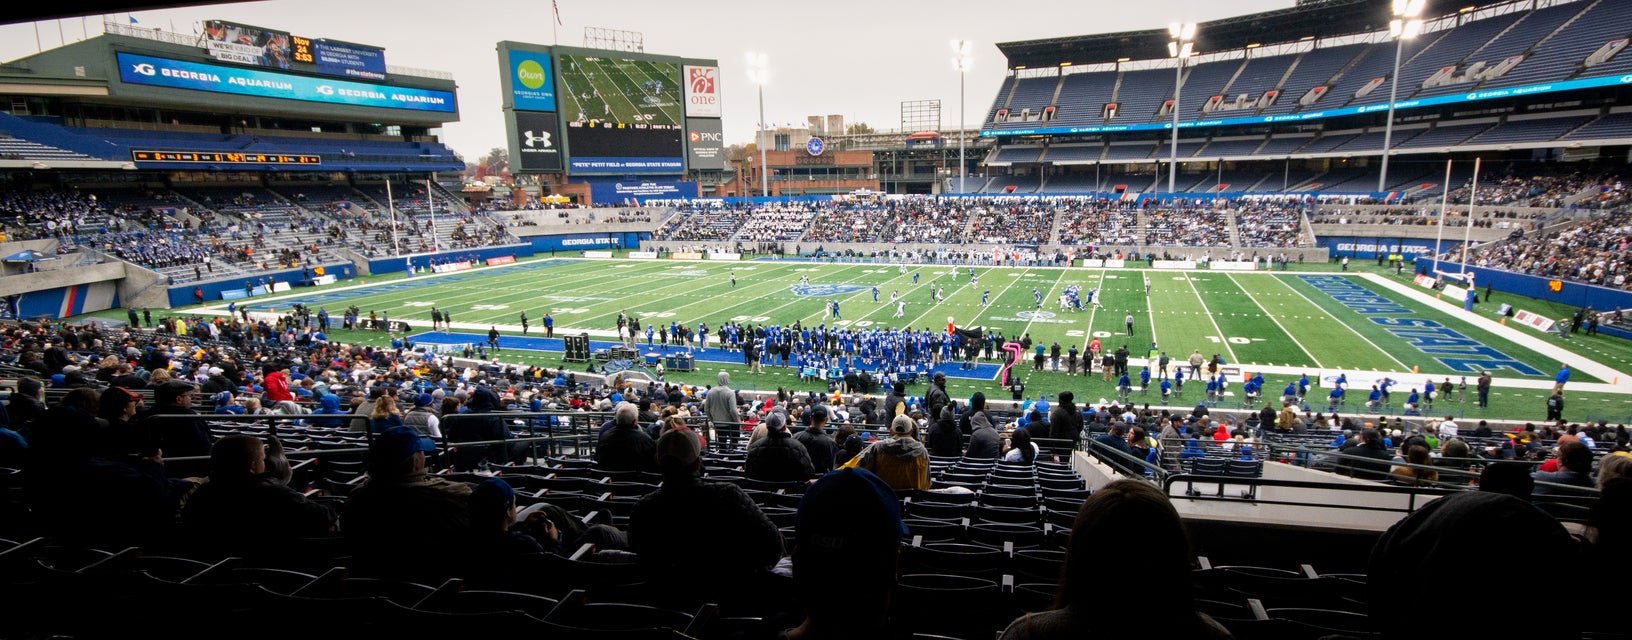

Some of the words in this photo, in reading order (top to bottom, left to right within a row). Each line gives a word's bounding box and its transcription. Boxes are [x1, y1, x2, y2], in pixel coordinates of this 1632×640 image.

[293, 36, 310, 46] Nov
[161, 68, 221, 82] GEORGIA
[228, 76, 292, 90] AQUARIUM
[520, 68, 543, 80] Own
[338, 88, 386, 100] GEORGIA
[392, 94, 444, 104] AQUARIUM
[692, 96, 716, 105] one
[701, 132, 722, 141] PNC
[1337, 243, 1388, 252] GEORGIA
[1549, 280, 1562, 292] 40
[1065, 330, 1112, 338] 20
[1205, 336, 1250, 344] 10
[1366, 316, 1551, 378] STATE
